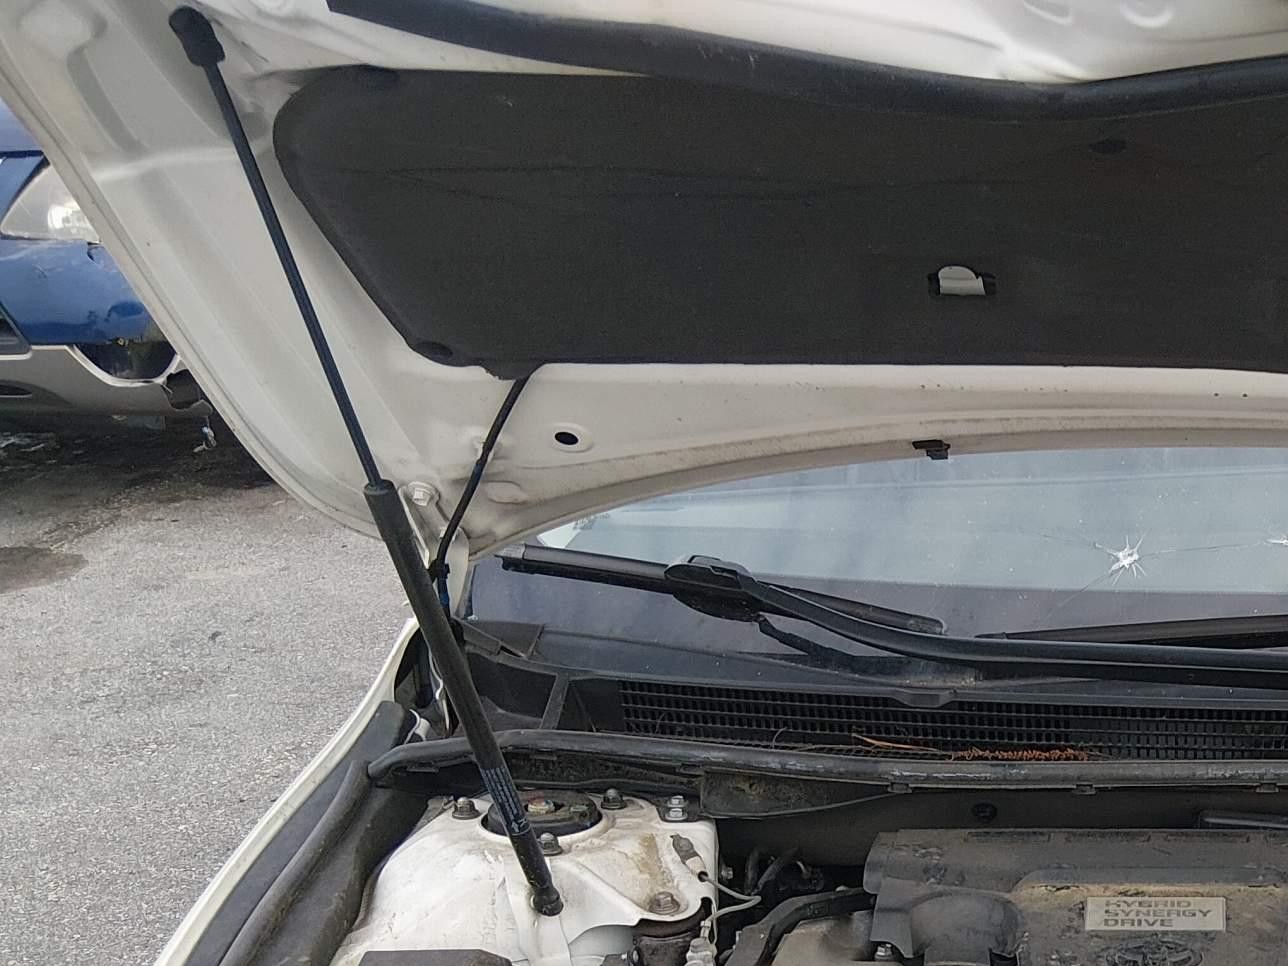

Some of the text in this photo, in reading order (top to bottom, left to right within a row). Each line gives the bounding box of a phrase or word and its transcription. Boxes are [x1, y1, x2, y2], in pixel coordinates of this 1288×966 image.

[1104, 899, 1191, 908] HYBRID
[1104, 909, 1212, 917] SYNERGY
[1104, 918, 1174, 927] DRIVE
